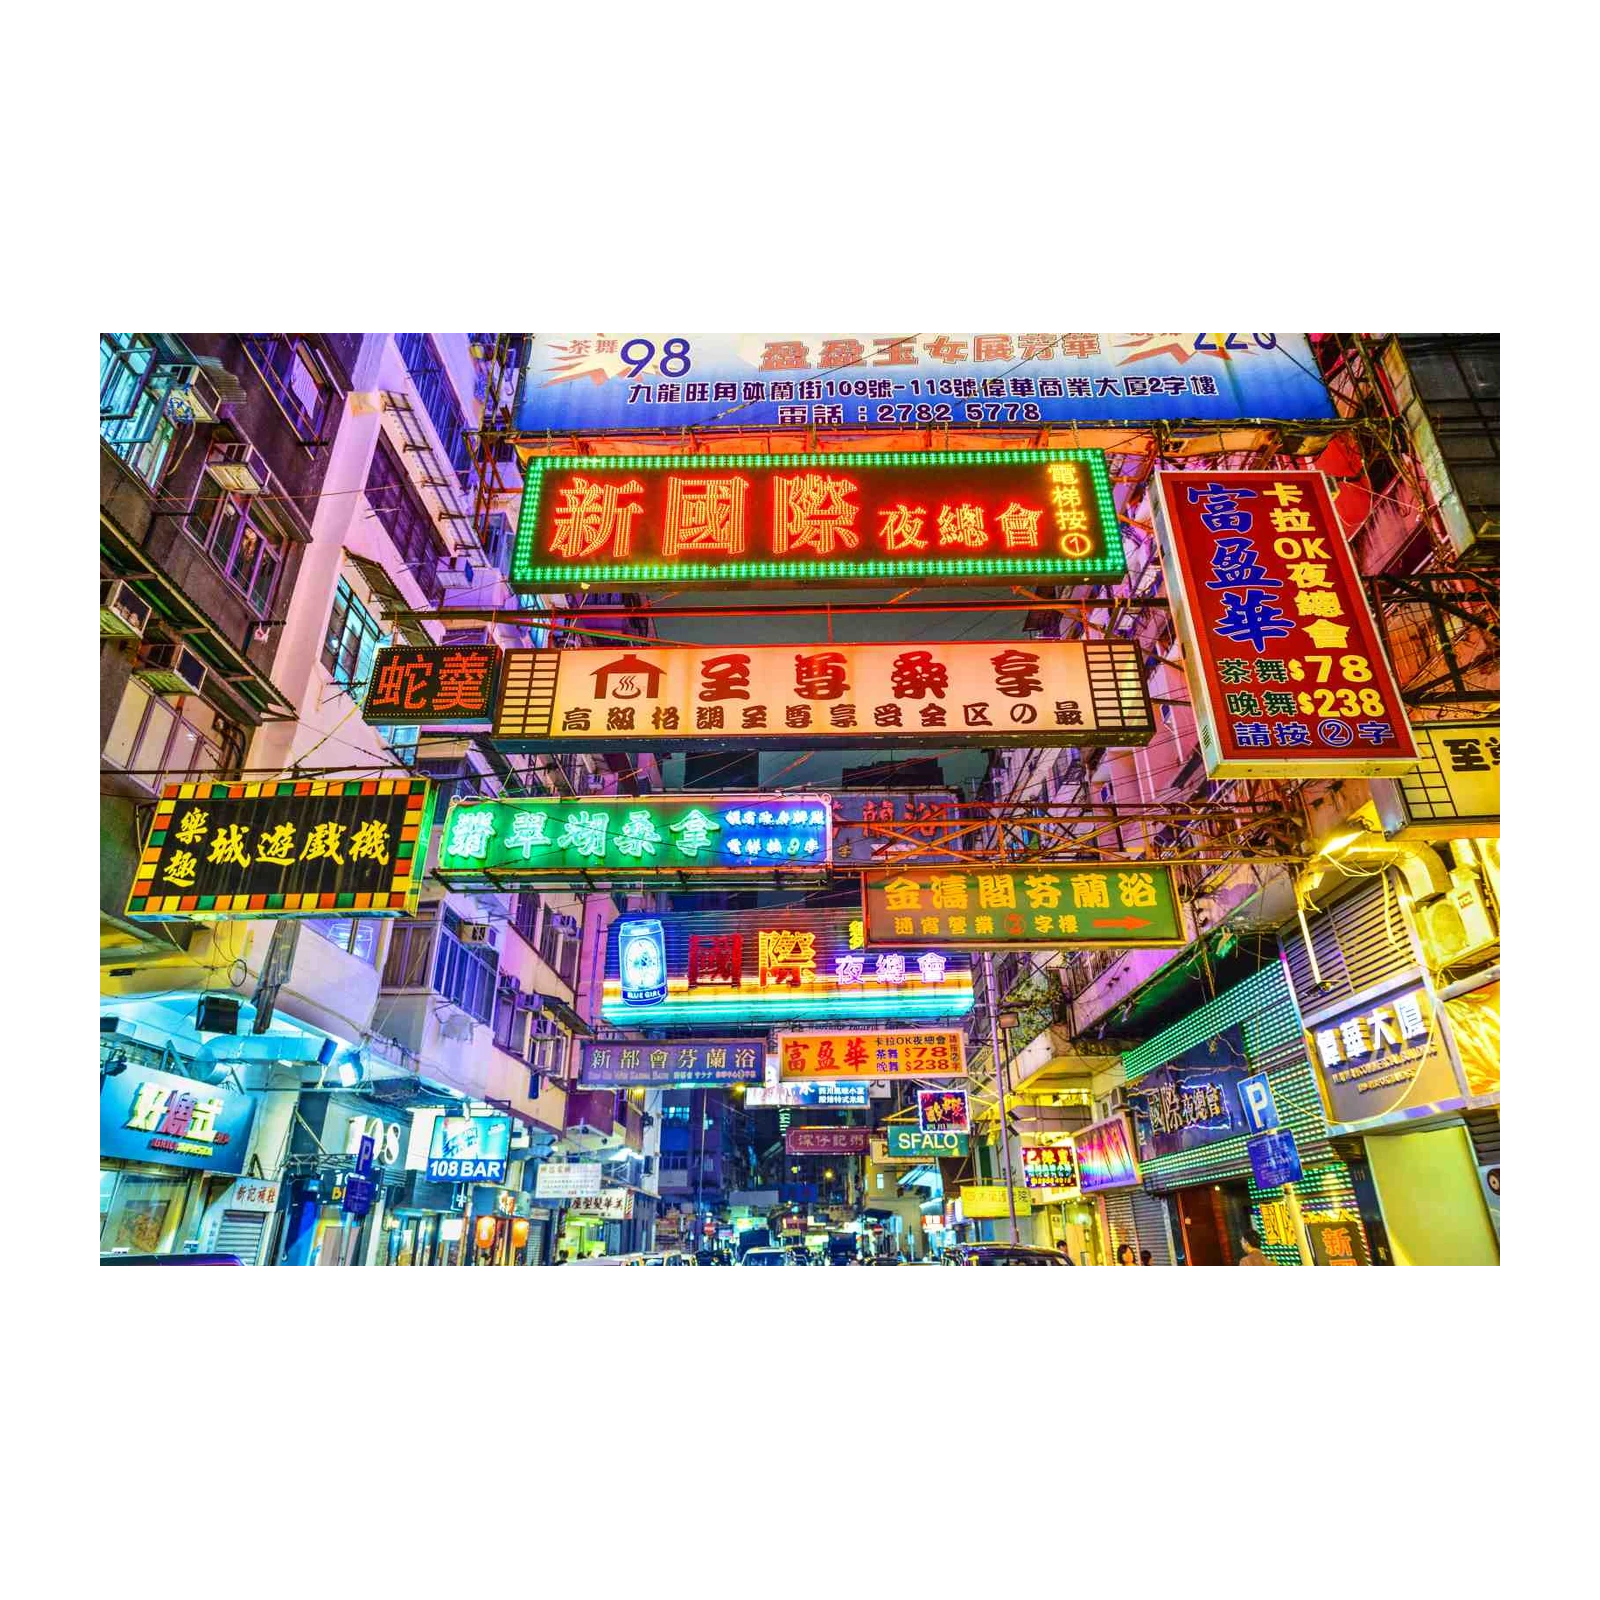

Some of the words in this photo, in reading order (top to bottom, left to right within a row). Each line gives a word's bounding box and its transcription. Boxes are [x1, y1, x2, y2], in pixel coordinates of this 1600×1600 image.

[568, 339, 618, 354] 茶舞
[620, 338, 692, 378] 98
[877, 403, 952, 423] 2782
[964, 402, 1041, 422] 5778
[1187, 482, 1296, 654] 富盈華
[372, 651, 487, 711] 蛇羹
[785, 1037, 870, 1073] 富盈華
[1246, 1081, 1268, 1128] P
[898, 1133, 959, 1150] SFALO
[430, 1160, 457, 1178] 108
[460, 1161, 501, 1178] BAR
